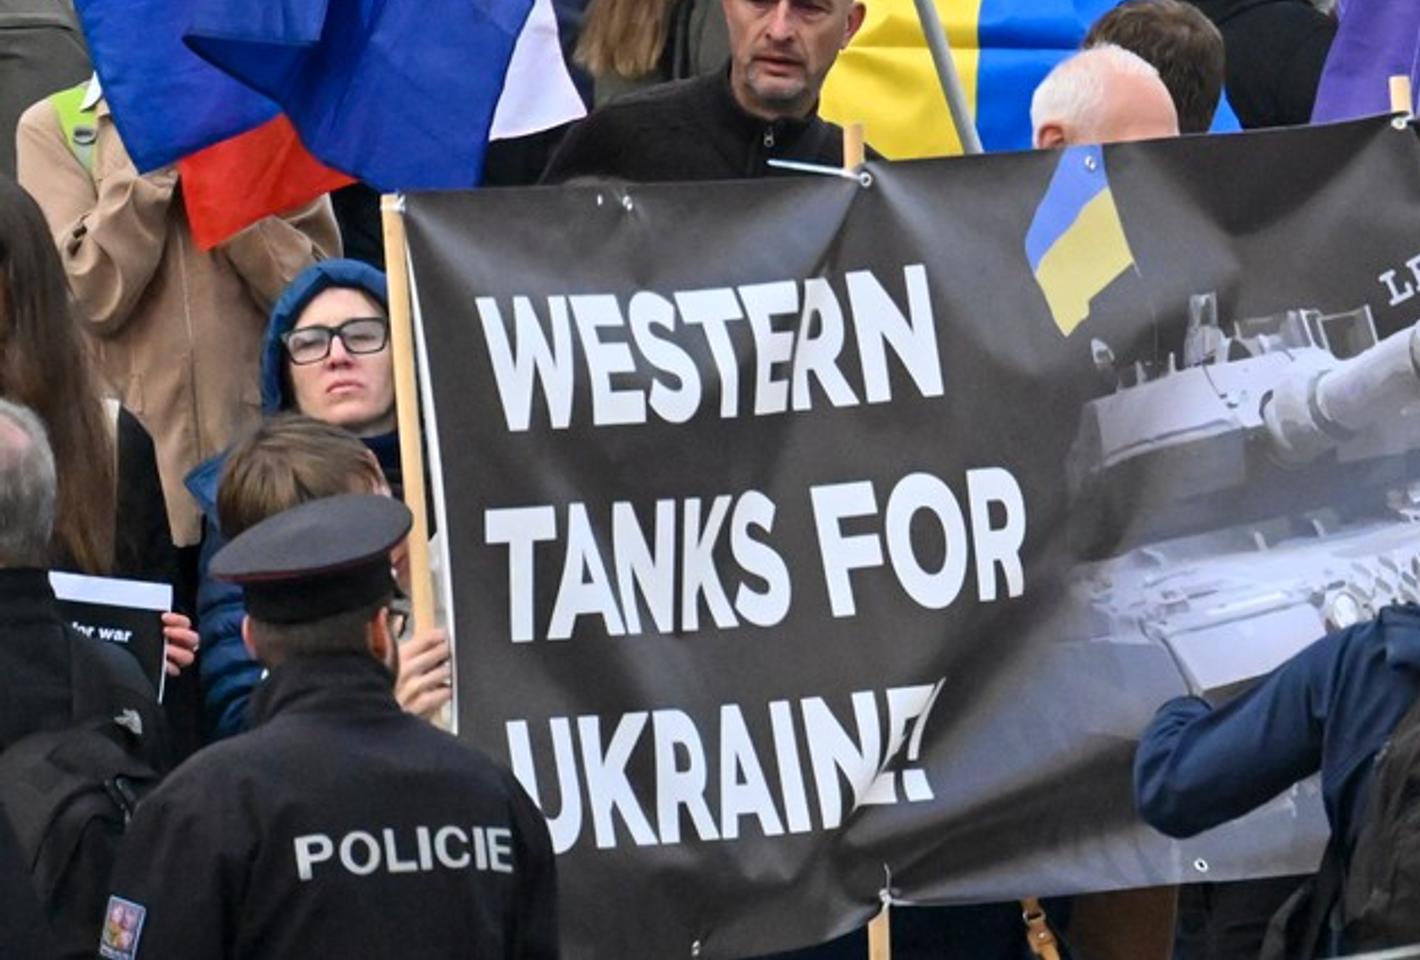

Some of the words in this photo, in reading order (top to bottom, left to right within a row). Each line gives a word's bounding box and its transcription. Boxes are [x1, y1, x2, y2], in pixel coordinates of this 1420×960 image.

[476, 264, 945, 432] WESTERN
[484, 489, 792, 643] TANKS
[809, 466, 1026, 617] FOR
[98, 627, 133, 643] war
[293, 825, 514, 881] POLICIE
